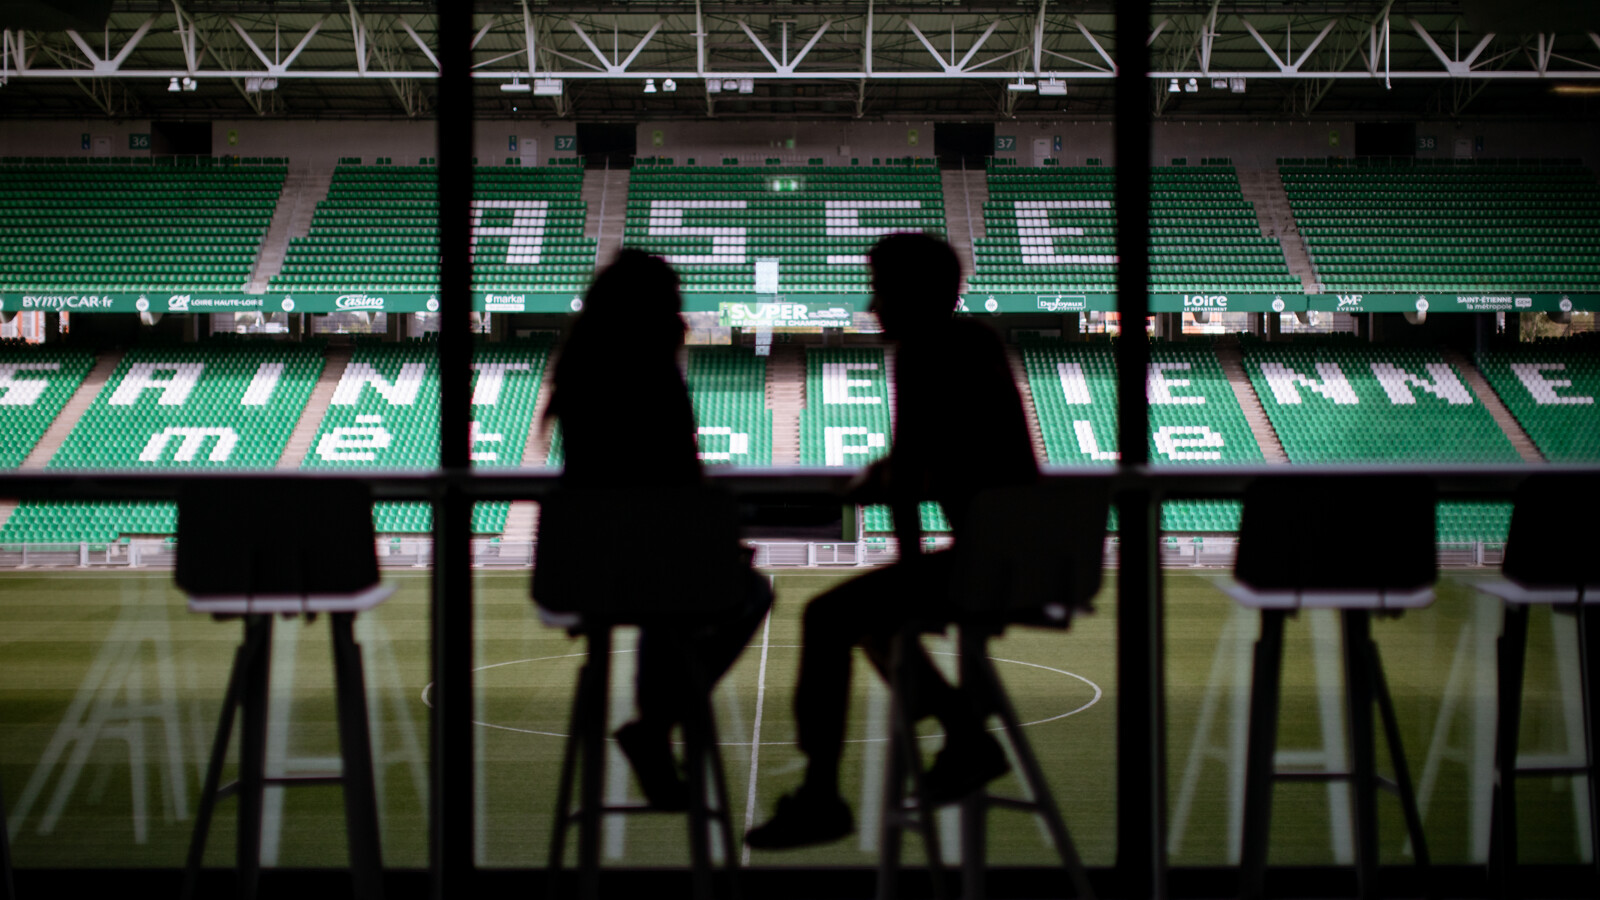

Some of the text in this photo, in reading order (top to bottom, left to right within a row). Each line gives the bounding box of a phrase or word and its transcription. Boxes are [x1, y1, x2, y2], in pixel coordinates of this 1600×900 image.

[131, 137, 148, 147] 36
[557, 138, 573, 149] 37
[997, 138, 1013, 149] 37
[1419, 138, 1435, 149] 38
[335, 295, 384, 308] Casino
[494, 294, 525, 303] markal
[1184, 295, 1227, 306] Loire
[1457, 295, 1512, 303] SAINT-ÉTIENNE
[731, 304, 808, 320] SUPER
[1475, 303, 1512, 311] métropole
